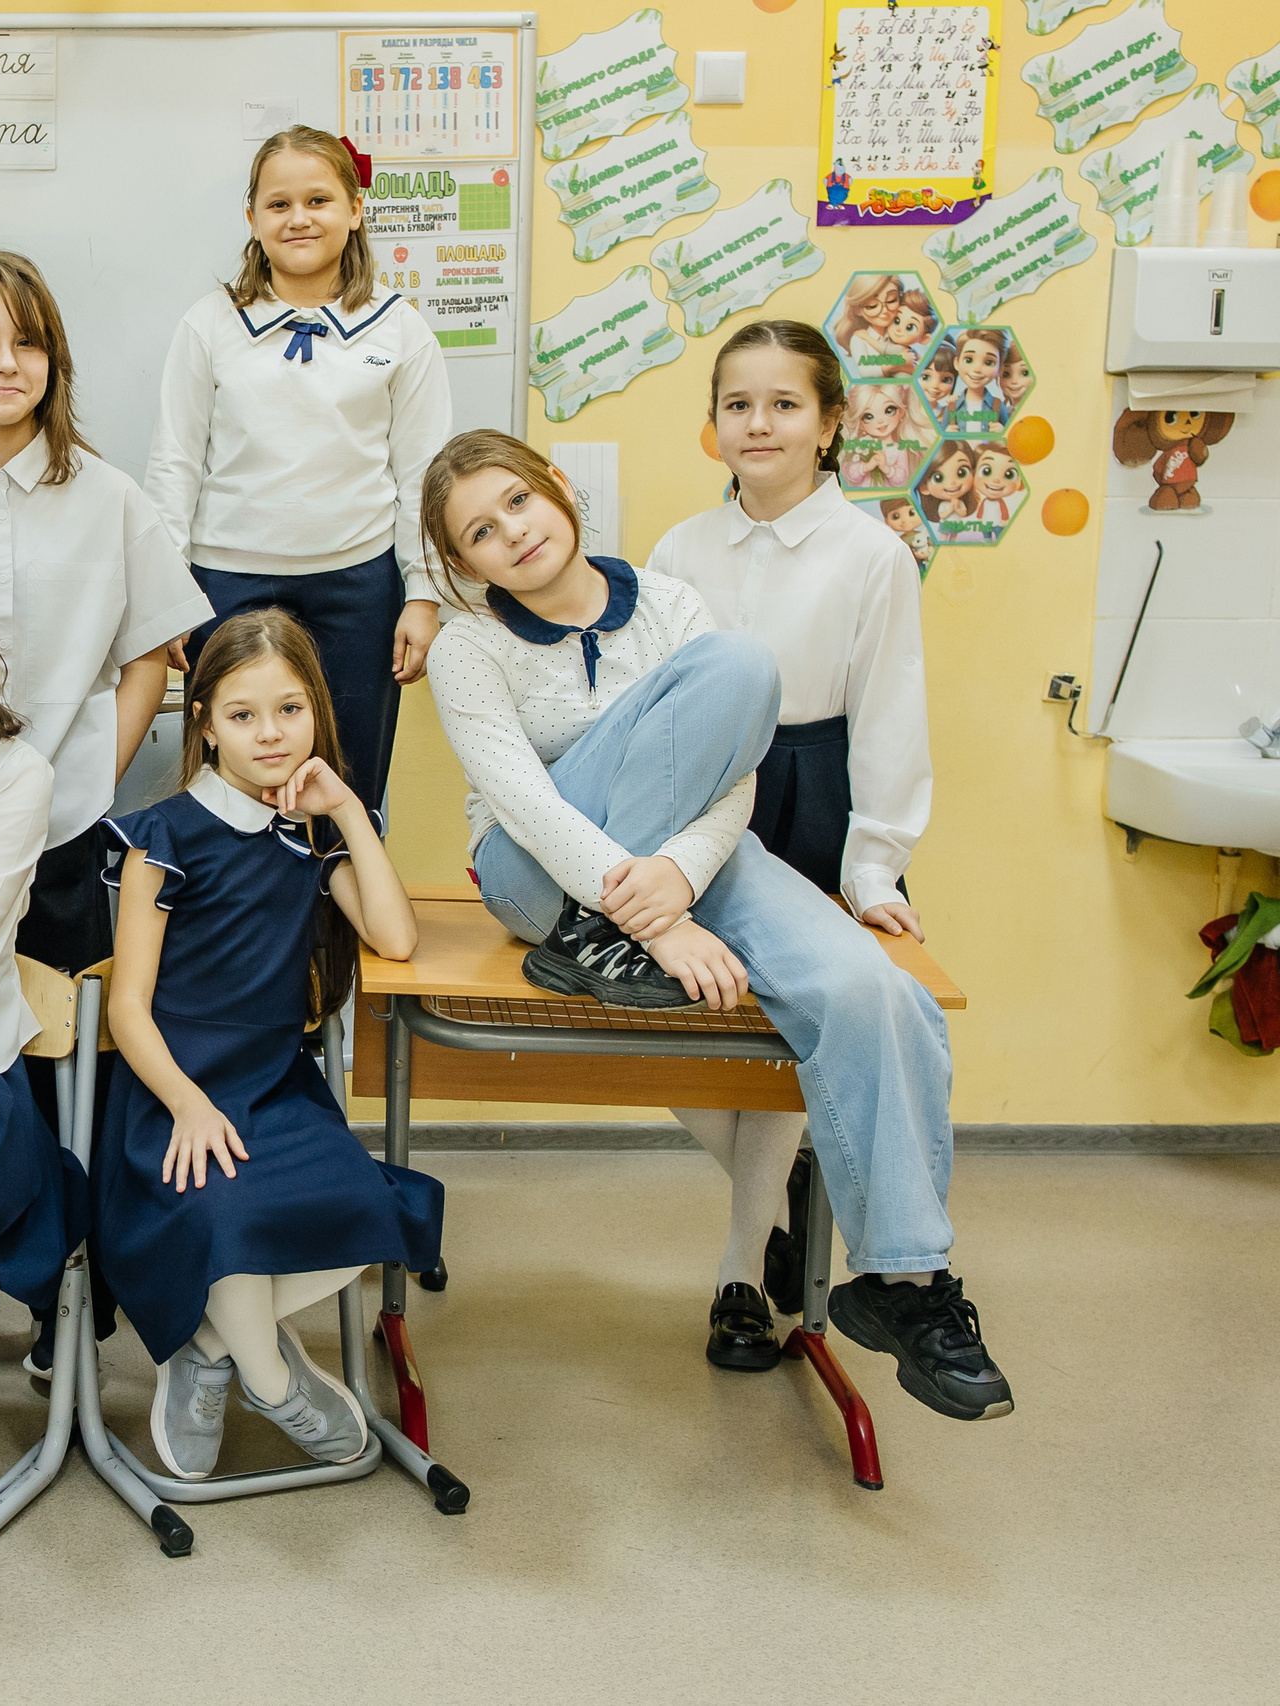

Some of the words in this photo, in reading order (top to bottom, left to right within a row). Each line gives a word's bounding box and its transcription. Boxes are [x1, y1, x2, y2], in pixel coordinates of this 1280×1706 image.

[898, 18, 916, 35] Вв
[381, 38, 411, 48] КЛАССЫ
[412, 38, 418, 47] И
[419, 38, 454, 47] РАЗРЯДЫ
[455, 37, 478, 46] ЧИСЕЛ
[350, 67, 385, 92] 835
[390, 67, 422, 90] 772
[428, 66, 461, 90] 138
[467, 65, 502, 89] 463
[558, 70, 605, 99] умного
[606, 47, 656, 75] соседа
[1049, 69, 1092, 98] Книга
[1091, 50, 1125, 73] твой
[552, 98, 601, 126] книгой
[600, 65, 674, 106] побеседуй
[1055, 104, 1080, 123] без
[1104, 76, 1130, 95] как
[1130, 62, 1154, 81] без
[624, 139, 678, 169] книжки
[620, 170, 673, 198] будешь
[1119, 156, 1160, 185] Книгу
[372, 205, 419, 213] ВНУТРЕННЯЯ
[422, 203, 444, 213] ЧАСТЬ
[423, 213, 457, 222] ПРИНЯТО
[623, 201, 662, 224] знать
[407, 222, 436, 232] БУКВОЙ
[942, 234, 991, 265] Золото
[993, 192, 1058, 240] добывают
[1025, 214, 1070, 246] знания
[436, 243, 506, 262] ПЛОЩАДЬ
[680, 250, 724, 278] Книги
[722, 226, 769, 254] читать
[442, 266, 500, 277] ПРОИЗВЕДЕНИЕ
[464, 277, 471, 286] И
[471, 276, 504, 285] ШИРИНЫ
[696, 269, 738, 298] скуки
[736, 261, 754, 276] не
[752, 242, 791, 266] знать
[994, 276, 1011, 291] из
[427, 298, 440, 307] ЭТО
[441, 297, 474, 306] ПЛОЩАДЬ
[474, 295, 509, 304] КВАДРАТА
[437, 307, 446, 315] СО
[448, 304, 482, 314] СТОРОНОЙ
[483, 304, 488, 312] 1
[536, 335, 586, 364] Чтение
[601, 300, 649, 332] лучшее
